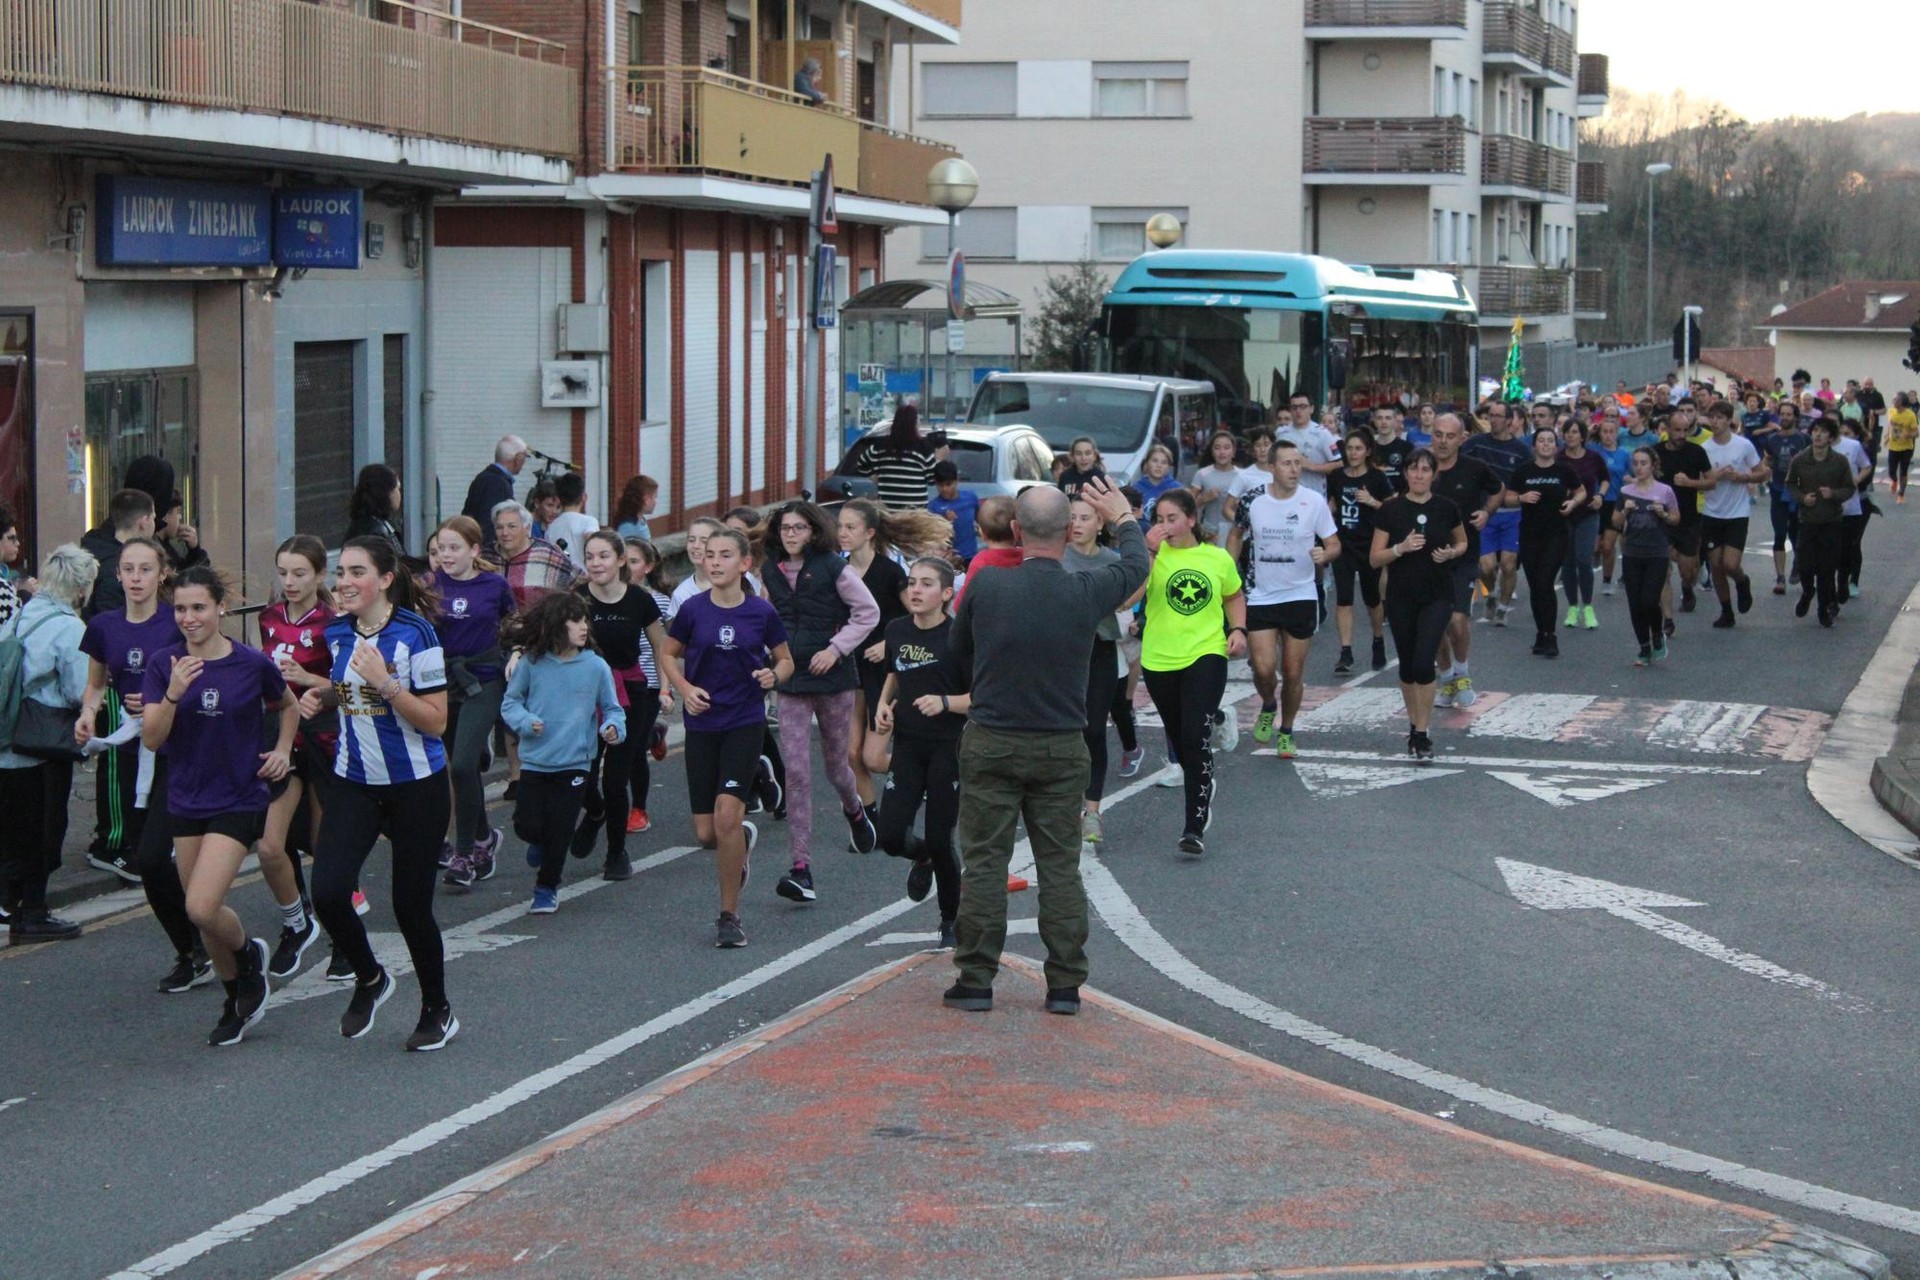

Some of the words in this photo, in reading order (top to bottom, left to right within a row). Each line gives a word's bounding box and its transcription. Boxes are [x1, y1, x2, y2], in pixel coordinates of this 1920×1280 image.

[280, 198, 351, 215] LAUROK
[122, 196, 174, 234] LAUROK
[188, 200, 256, 237] ZINEBANK
[1172, 574, 1207, 589] ASTURIAS
[899, 644, 934, 662] Nike
